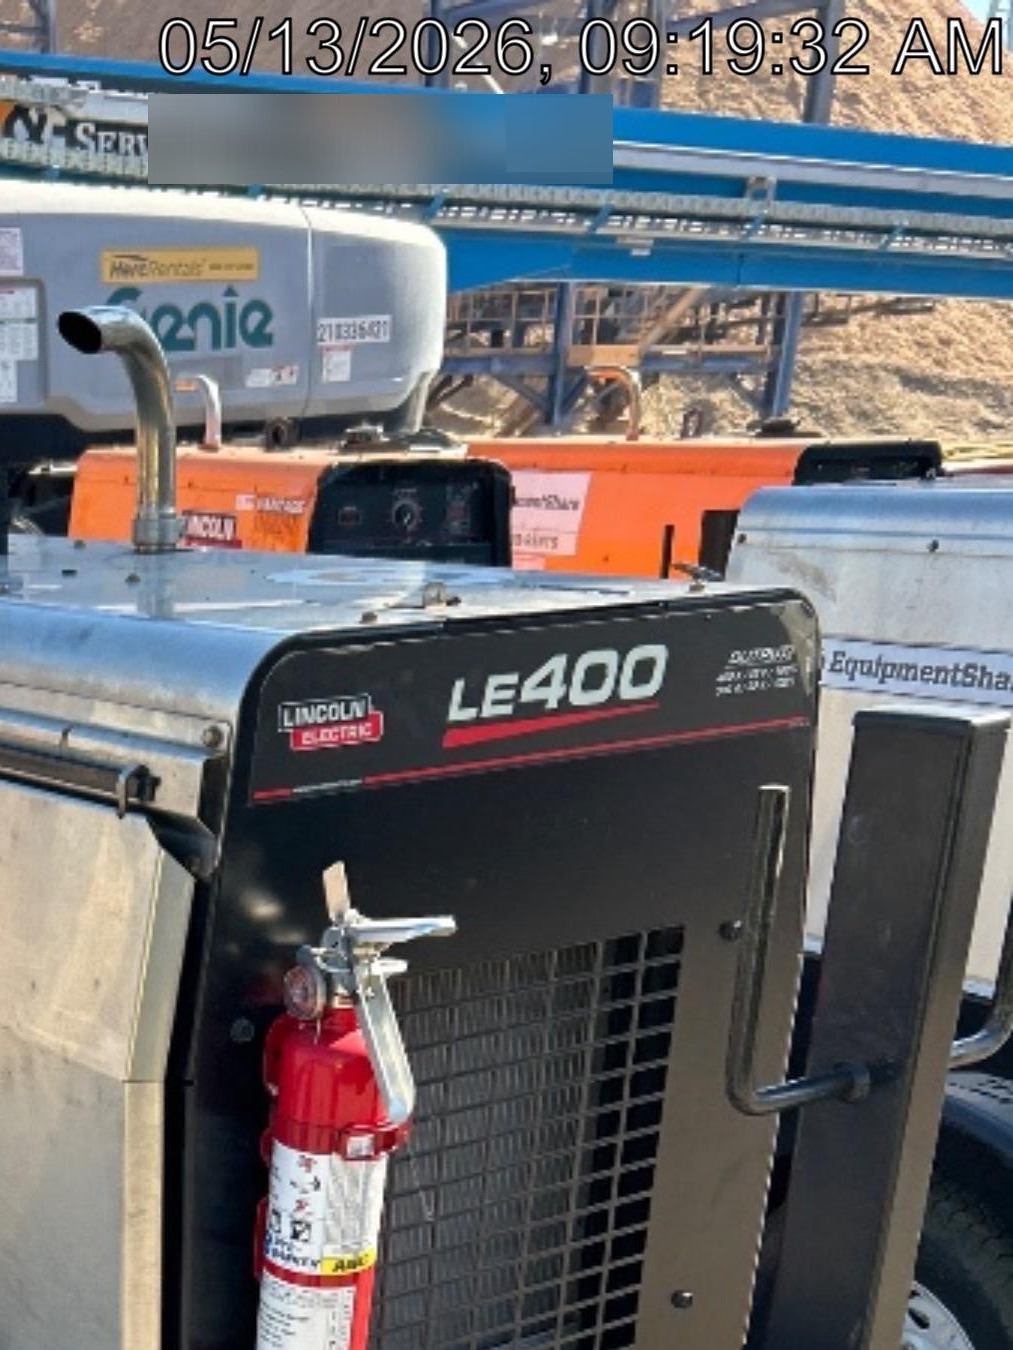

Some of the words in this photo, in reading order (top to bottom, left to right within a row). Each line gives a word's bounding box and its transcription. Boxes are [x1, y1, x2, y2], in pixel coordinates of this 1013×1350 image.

[186, 515, 235, 541] INCOLN
[447, 643, 668, 722] LE400
[828, 650, 1013, 693] EquipmentSha
[283, 699, 366, 727] LINCOLN
[301, 722, 373, 745] ELECTRIC
